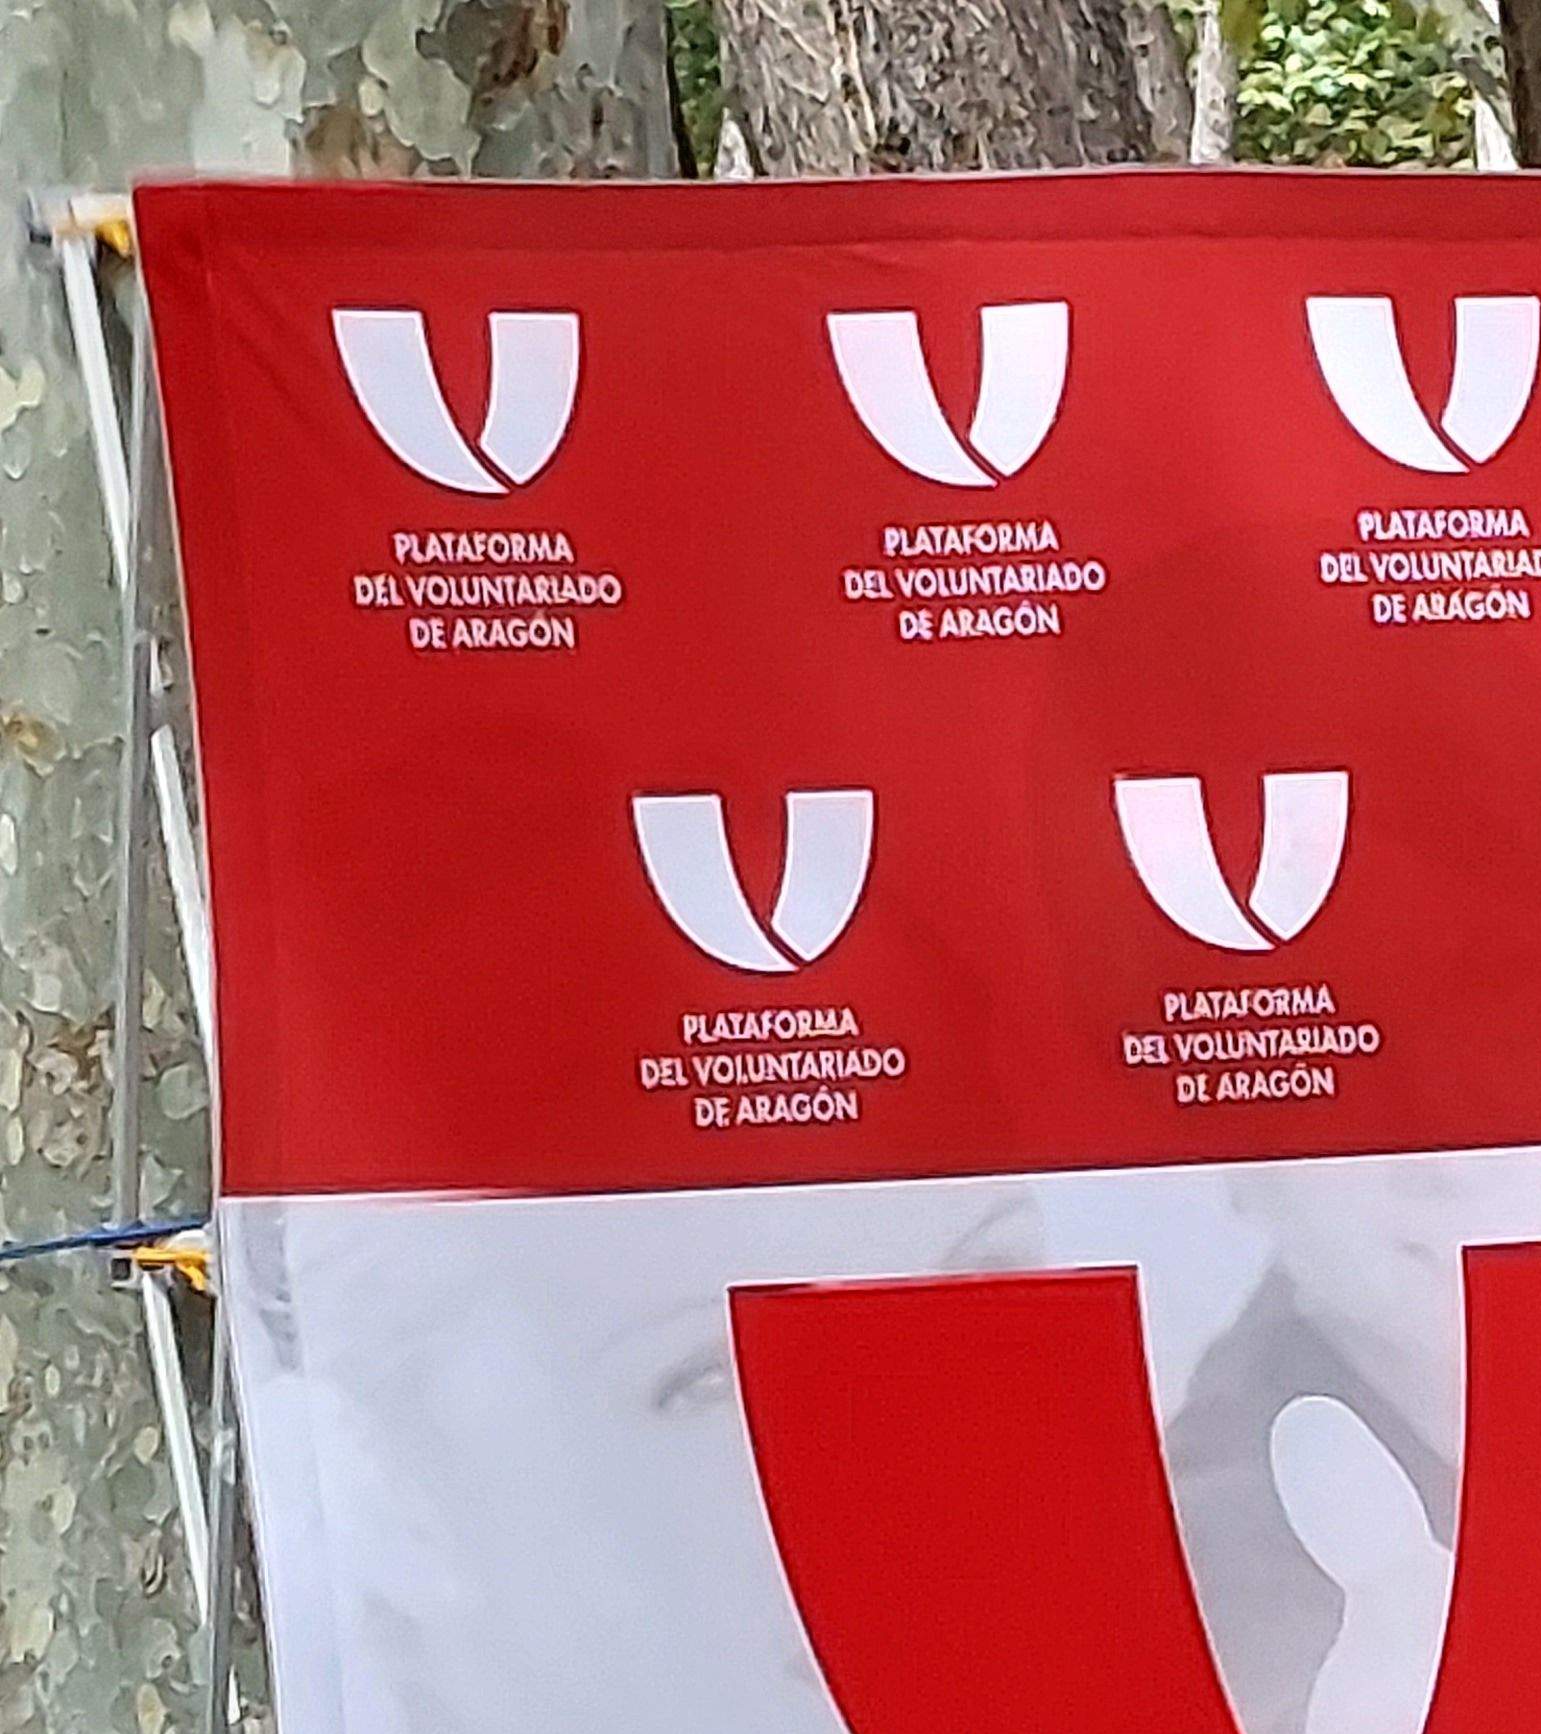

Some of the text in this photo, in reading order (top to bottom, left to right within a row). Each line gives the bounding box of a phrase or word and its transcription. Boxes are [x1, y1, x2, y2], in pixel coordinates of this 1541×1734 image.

[883, 520, 1060, 558] PLATAFORMA
[1356, 508, 1531, 542] PLATAFORMA
[392, 531, 575, 564] PLATAFORMA
[1319, 551, 1370, 584] DEL
[352, 573, 623, 608] DEL VOLUNTARIADO
[843, 560, 1107, 600] DEL VOLUNTARIADO
[898, 599, 1062, 641] DE ARAGÓN
[1371, 582, 1532, 624] DE ARAGÓN
[408, 611, 576, 649] DE ARAGÓN
[1163, 983, 1337, 1023] PLATAFORMA
[682, 1007, 860, 1045] PLATAFORMA
[1122, 1023, 1381, 1065] DEL VOLUNTARIADO
[640, 1046, 906, 1090] DEL VOLUNTARIADO
[1175, 1062, 1335, 1104] DE ARAGÓN
[693, 1084, 859, 1128] DE ARAGÓN
